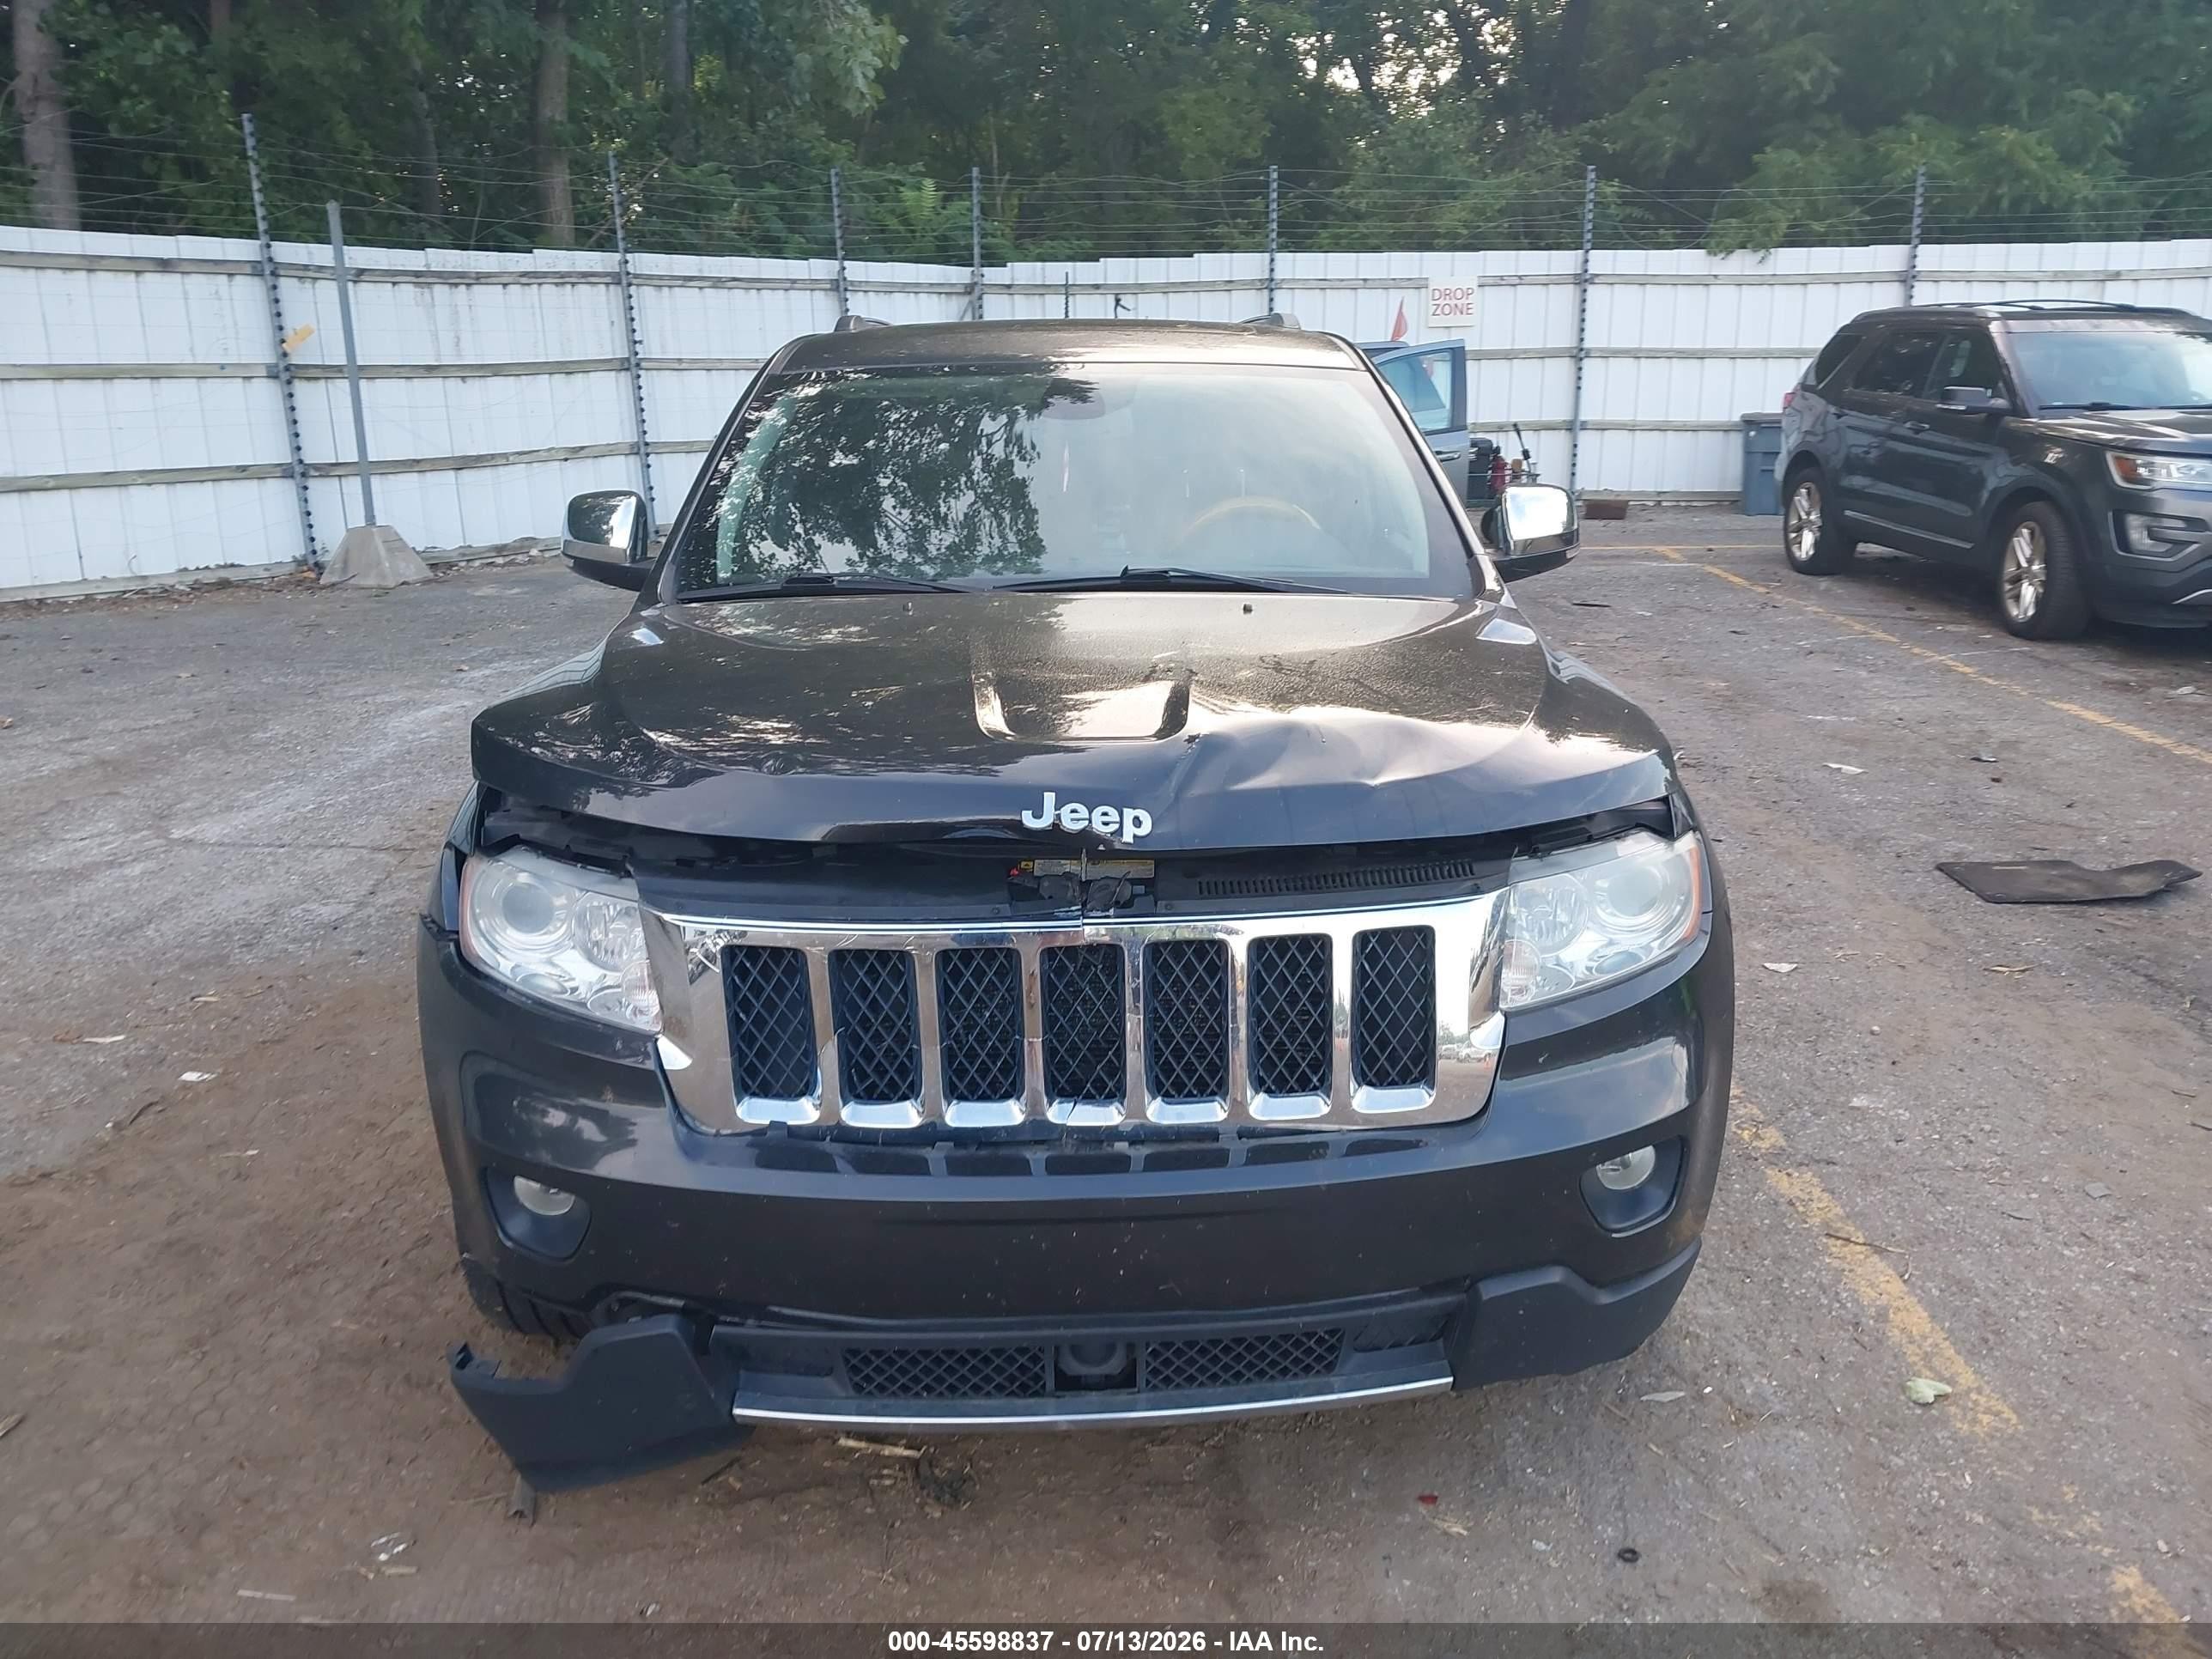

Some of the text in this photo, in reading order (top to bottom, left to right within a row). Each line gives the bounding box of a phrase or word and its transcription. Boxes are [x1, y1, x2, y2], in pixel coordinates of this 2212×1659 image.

[1431, 288, 1474, 301] DROP
[1431, 303, 1474, 316] ZONE
[1021, 792, 1152, 843] Jeep
